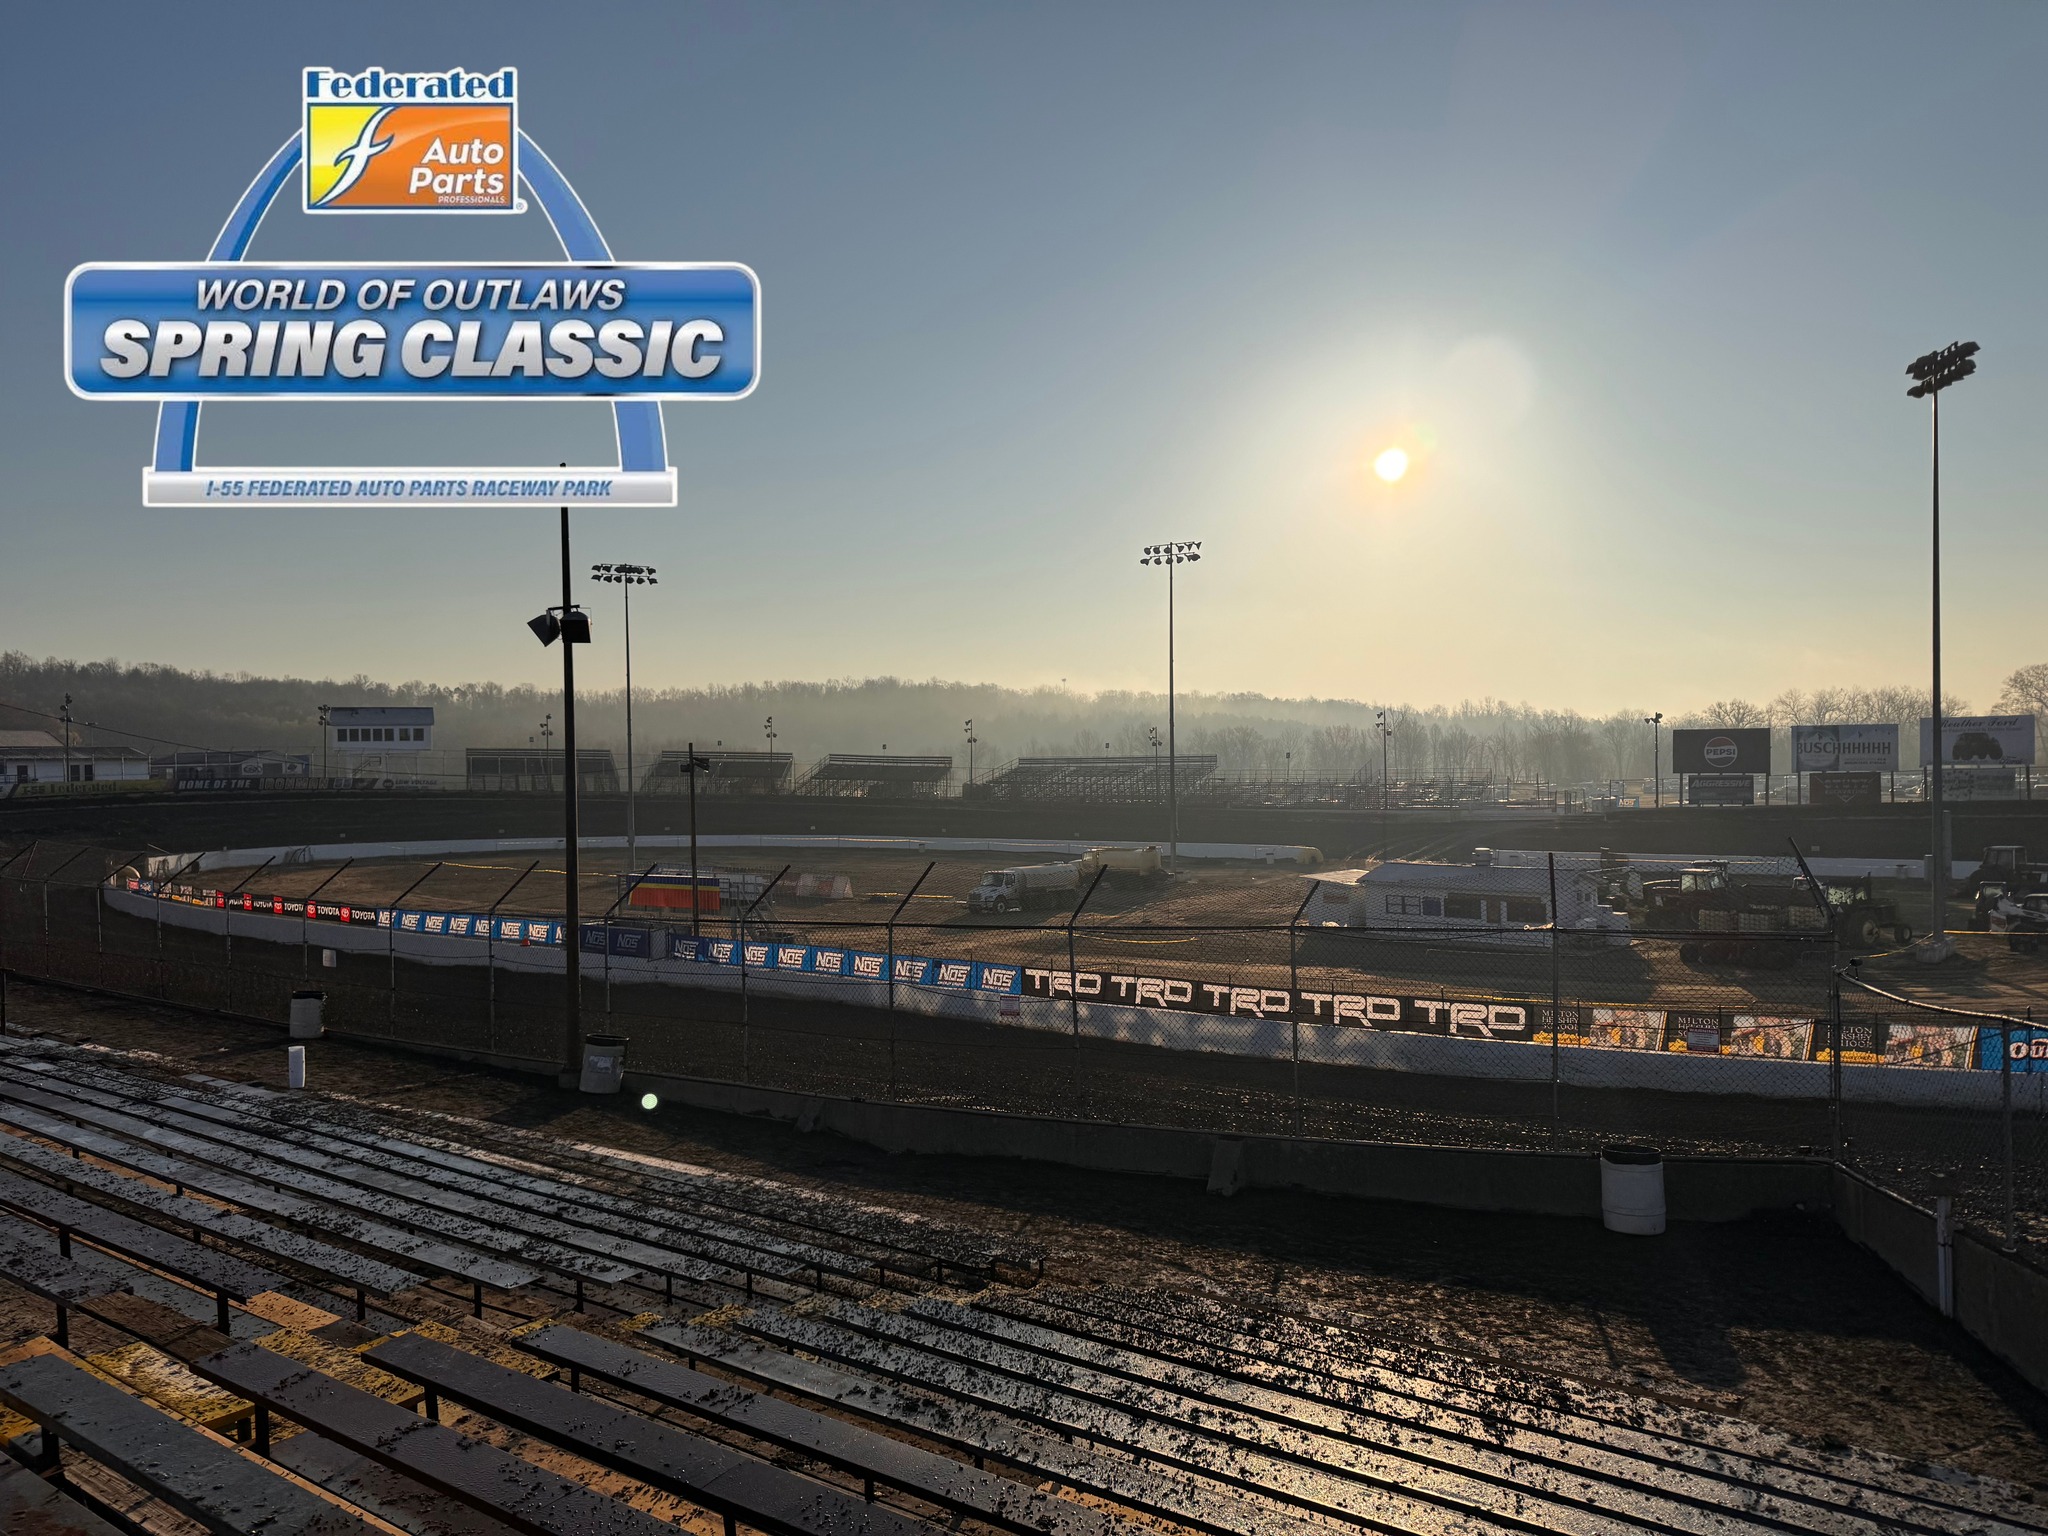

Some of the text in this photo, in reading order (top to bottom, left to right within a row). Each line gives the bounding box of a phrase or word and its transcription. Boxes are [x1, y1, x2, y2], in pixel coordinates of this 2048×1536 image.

[1706, 748, 1736, 756] PEPSI
[178, 780, 210, 790] HOME
[213, 779, 227, 789] OF
[231, 779, 251, 788] THE
[258, 778, 329, 790] IRONMAN
[1690, 779, 1752, 788] AGGRESSIVE
[317, 906, 340, 916] TOYOTA
[351, 909, 376, 921] TOYOTA
[425, 915, 445, 929] NOS
[450, 916, 470, 931] NOS
[502, 922, 522, 937] NOS
[528, 923, 549, 939] NOS
[585, 929, 605, 945] NOS
[616, 933, 641, 948] NOS
[675, 939, 699, 955] NOS
[708, 943, 733, 958] NOS
[778, 948, 806, 965] NOS
[816, 951, 844, 968] NOS
[854, 955, 884, 974] NOS
[894, 959, 928, 978] NOS
[938, 964, 971, 982] NOS
[982, 967, 1016, 987] NOS
[1024, 968, 1102, 997] TRD
[1110, 975, 1193, 1007] TRD
[1202, 983, 1290, 1018] TRD
[1301, 992, 1401, 1028] TRD
[1542, 1009, 1579, 1018] MITON
[1414, 999, 1526, 1039] TRD
[1542, 1016, 1579, 1024] HESHEY
[1678, 1016, 1719, 1025] MILTON
